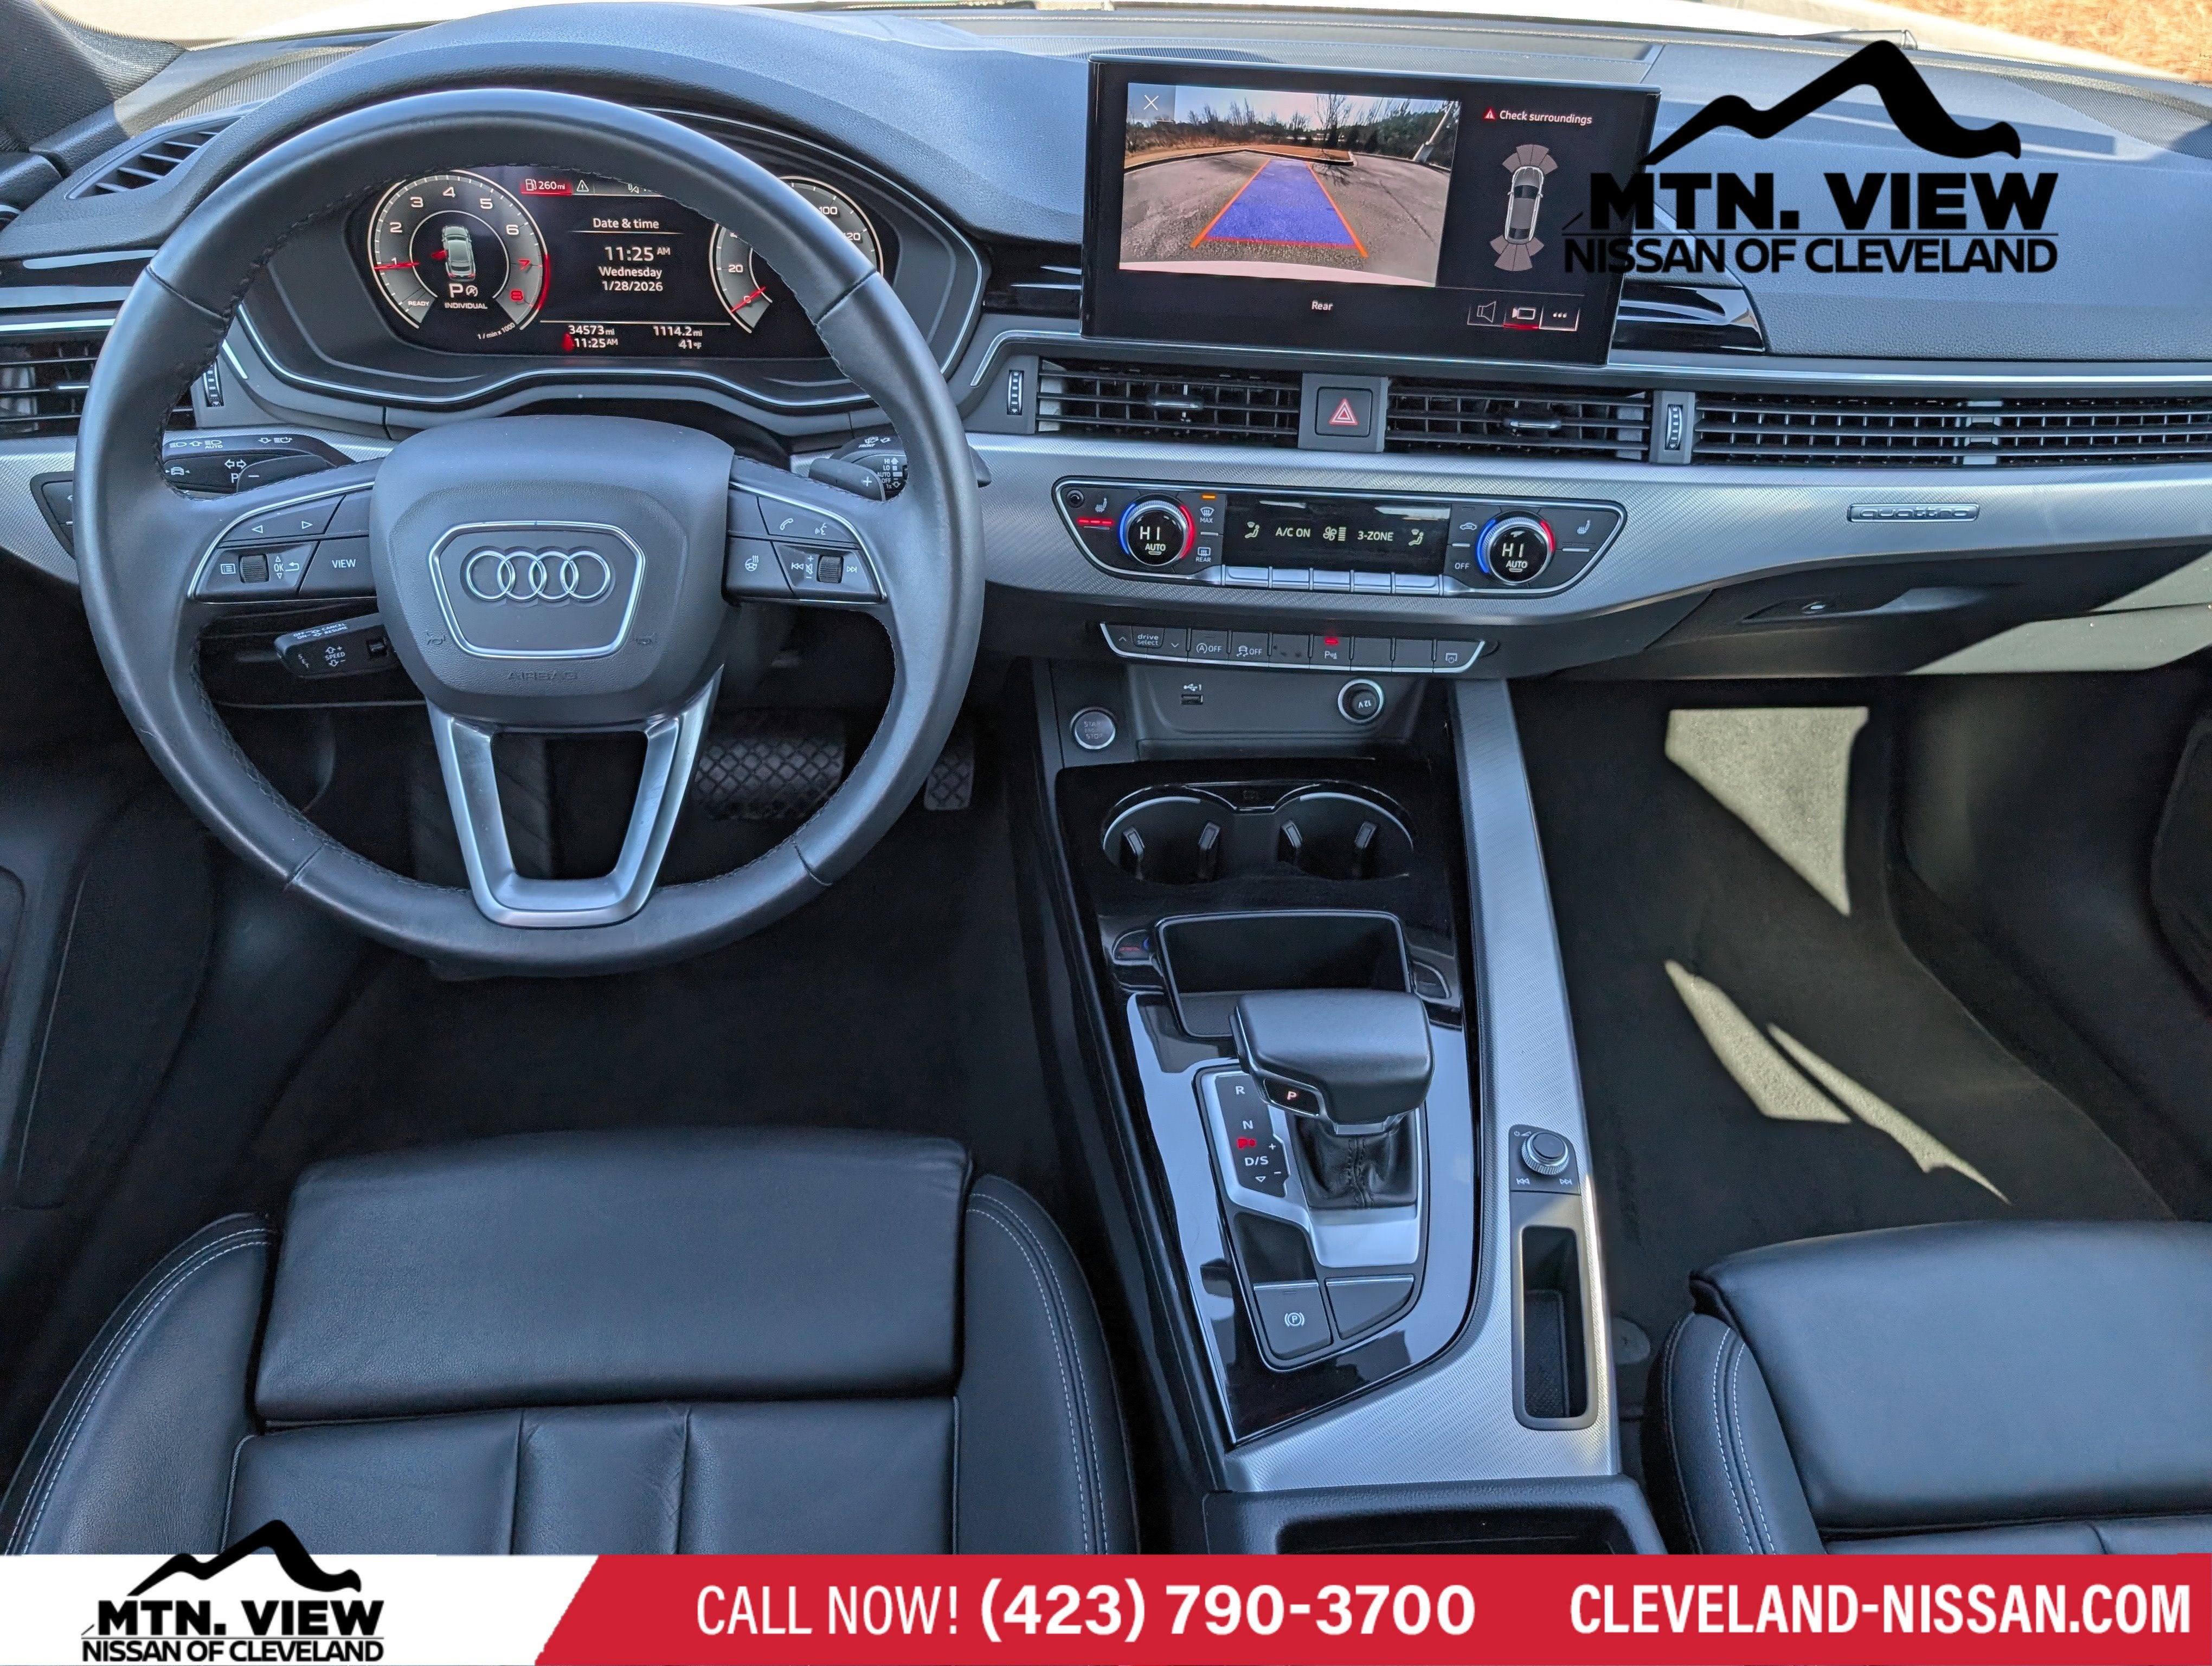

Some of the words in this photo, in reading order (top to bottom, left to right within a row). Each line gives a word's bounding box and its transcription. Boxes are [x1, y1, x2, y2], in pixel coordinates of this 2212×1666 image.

[1499, 110, 1527, 121] Check
[1528, 113, 1592, 126] surroundings
[442, 187, 456, 198] 4
[410, 197, 423, 208] 3
[480, 198, 493, 209] 5
[819, 206, 838, 215] 100
[389, 221, 403, 233] 2
[593, 218, 619, 229] Date
[622, 219, 632, 229] &
[633, 218, 660, 229] time
[506, 225, 519, 235] 6
[605, 247, 654, 261] 11:25
[657, 247, 671, 255] AM
[518, 259, 531, 270] 7
[729, 264, 744, 273] 20
[599, 266, 663, 279] Wednesday
[448, 284, 463, 298] P
[602, 281, 663, 292] 1/28/2026
[510, 290, 524, 302] 8
[445, 302, 488, 310] INDIVIDUAL
[1311, 300, 1333, 311] Rear
[1275, 527, 1294, 537] A/C
[1296, 528, 1311, 538] ON
[1358, 531, 1394, 542] 3-ZONE
[1145, 543, 1166, 552] AUTO
[274, 563, 284, 573] OK
[332, 559, 357, 569] VIEW
[1506, 560, 1528, 569] AUTO
[325, 651, 345, 661] SPEED
[1235, 1086, 1245, 1095] R
[1287, 1091, 1297, 1100] P
[1243, 1120, 1253, 1130] N
[1245, 1156, 1269, 1166] D/S
